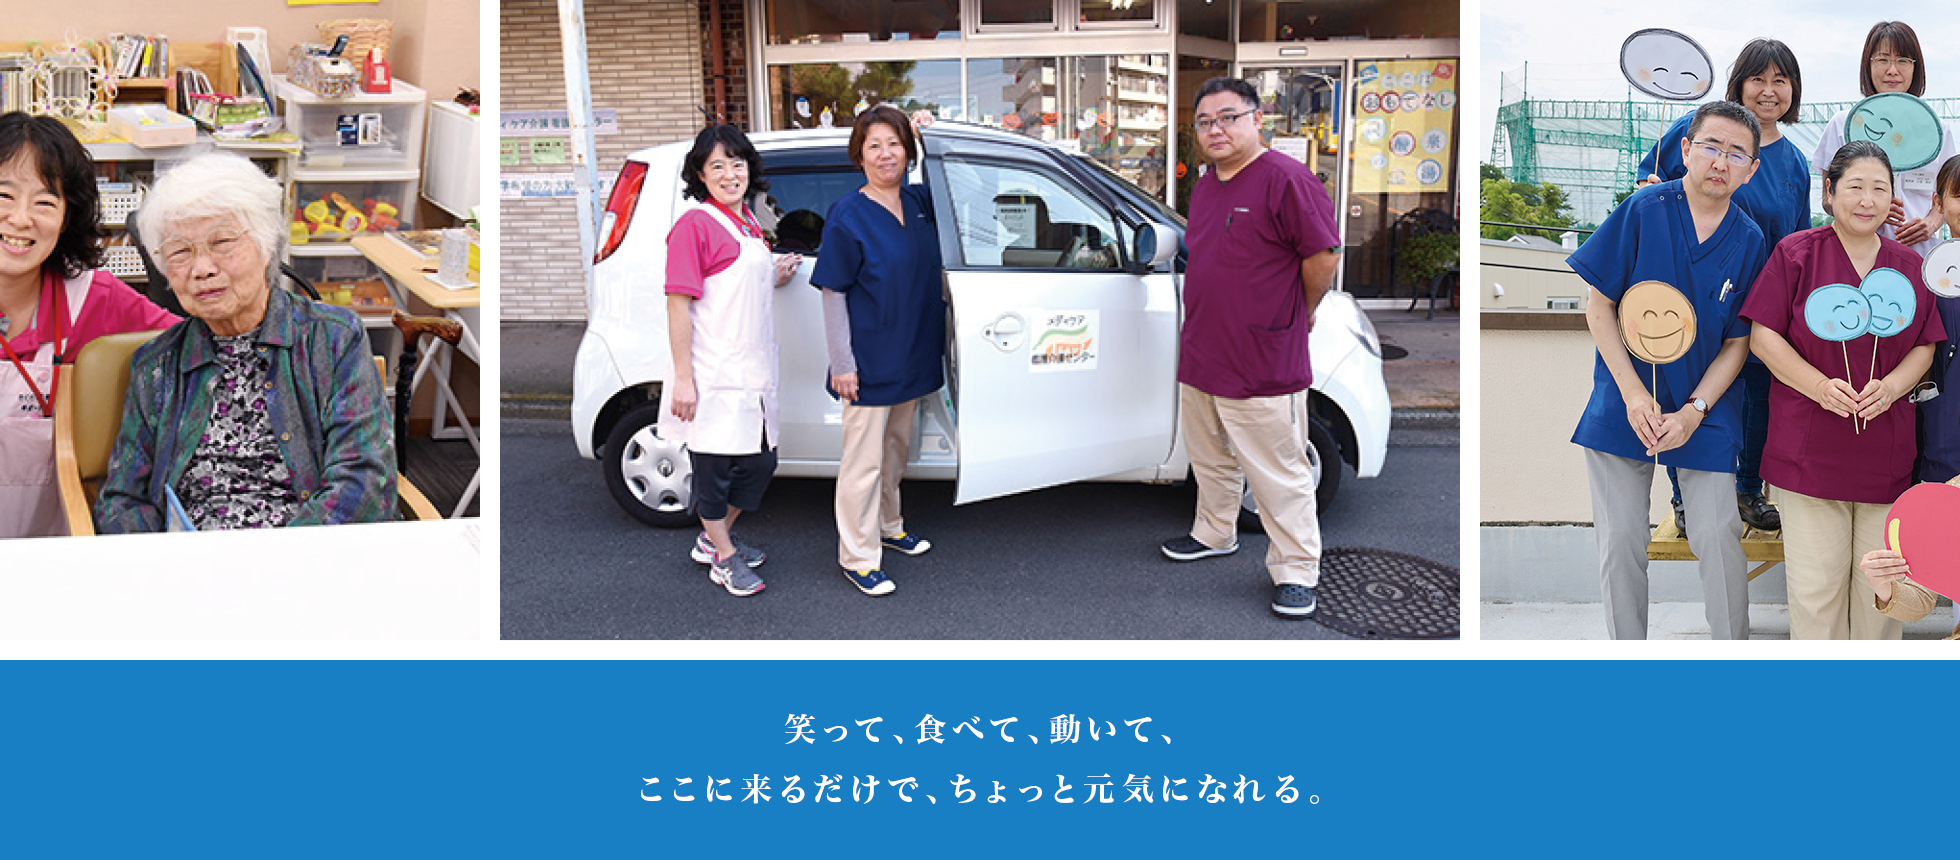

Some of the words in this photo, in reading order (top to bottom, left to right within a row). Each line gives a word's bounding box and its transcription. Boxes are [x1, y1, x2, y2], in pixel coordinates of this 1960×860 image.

[1363, 92, 1452, 110] おもてなし
[1046, 314, 1086, 327] メディケア
